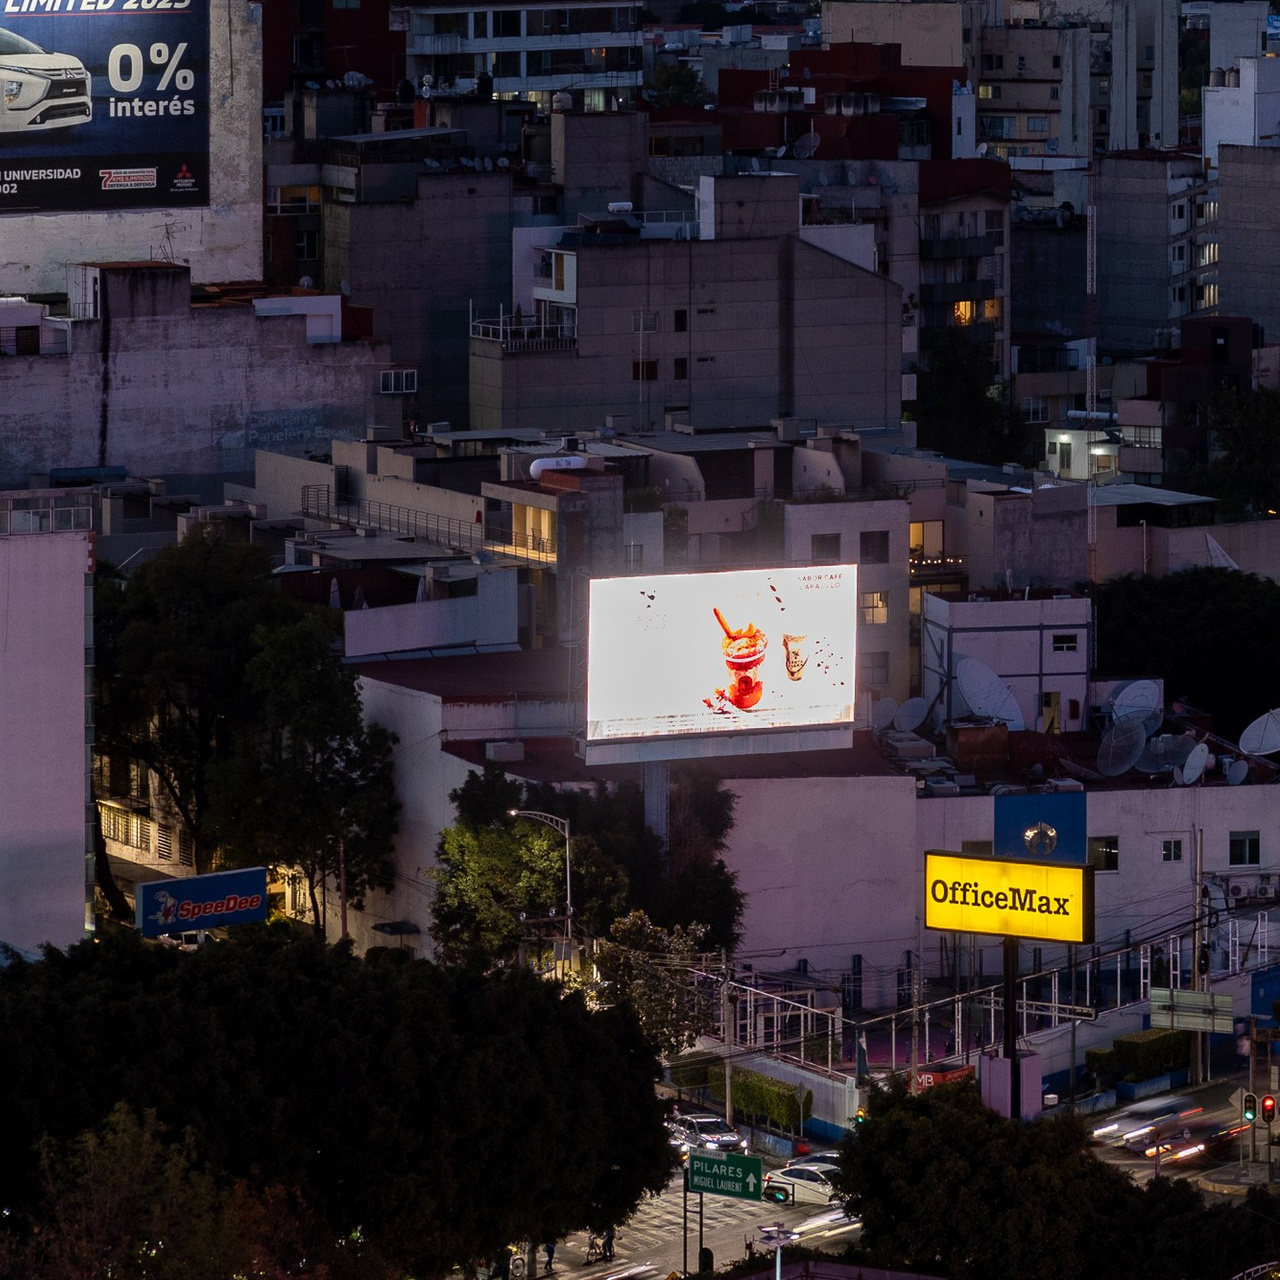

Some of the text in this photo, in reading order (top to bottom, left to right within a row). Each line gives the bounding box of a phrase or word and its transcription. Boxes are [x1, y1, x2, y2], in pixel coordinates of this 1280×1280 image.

[108, 42, 195, 93] 0%
[109, 95, 195, 117] interés
[4, 168, 81, 181] UNIVERSIDAD
[101, 171, 113, 188] 7
[931, 879, 1070, 916] OfficeMax
[178, 895, 262, 921] SpeeDee
[693, 1161, 743, 1178] PILARES
[694, 1175, 743, 1192] MIGUEL LAURENT
